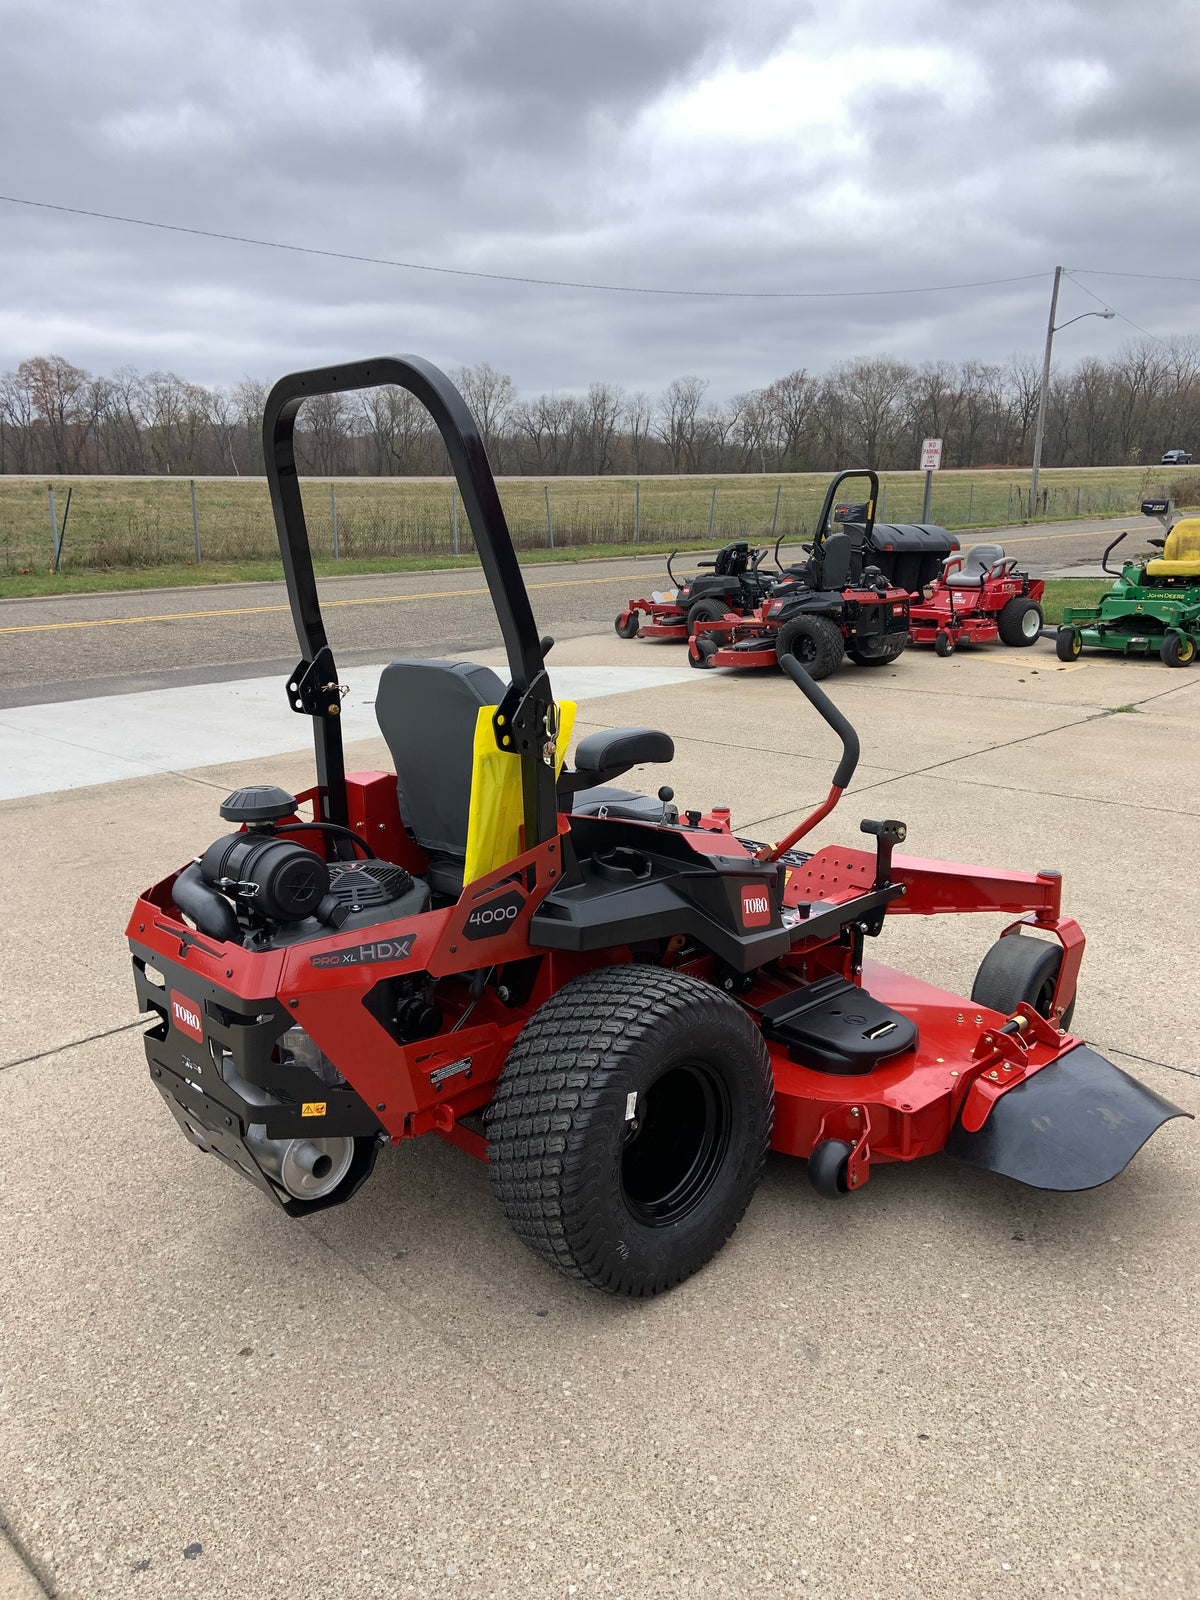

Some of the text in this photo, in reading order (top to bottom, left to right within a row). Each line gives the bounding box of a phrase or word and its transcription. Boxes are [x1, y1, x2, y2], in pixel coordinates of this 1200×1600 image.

[469, 905, 518, 926] 4000
[744, 897, 768, 914] TORO
[311, 940, 410, 967] PRO XL HDX
[173, 1002, 201, 1031] TORO
